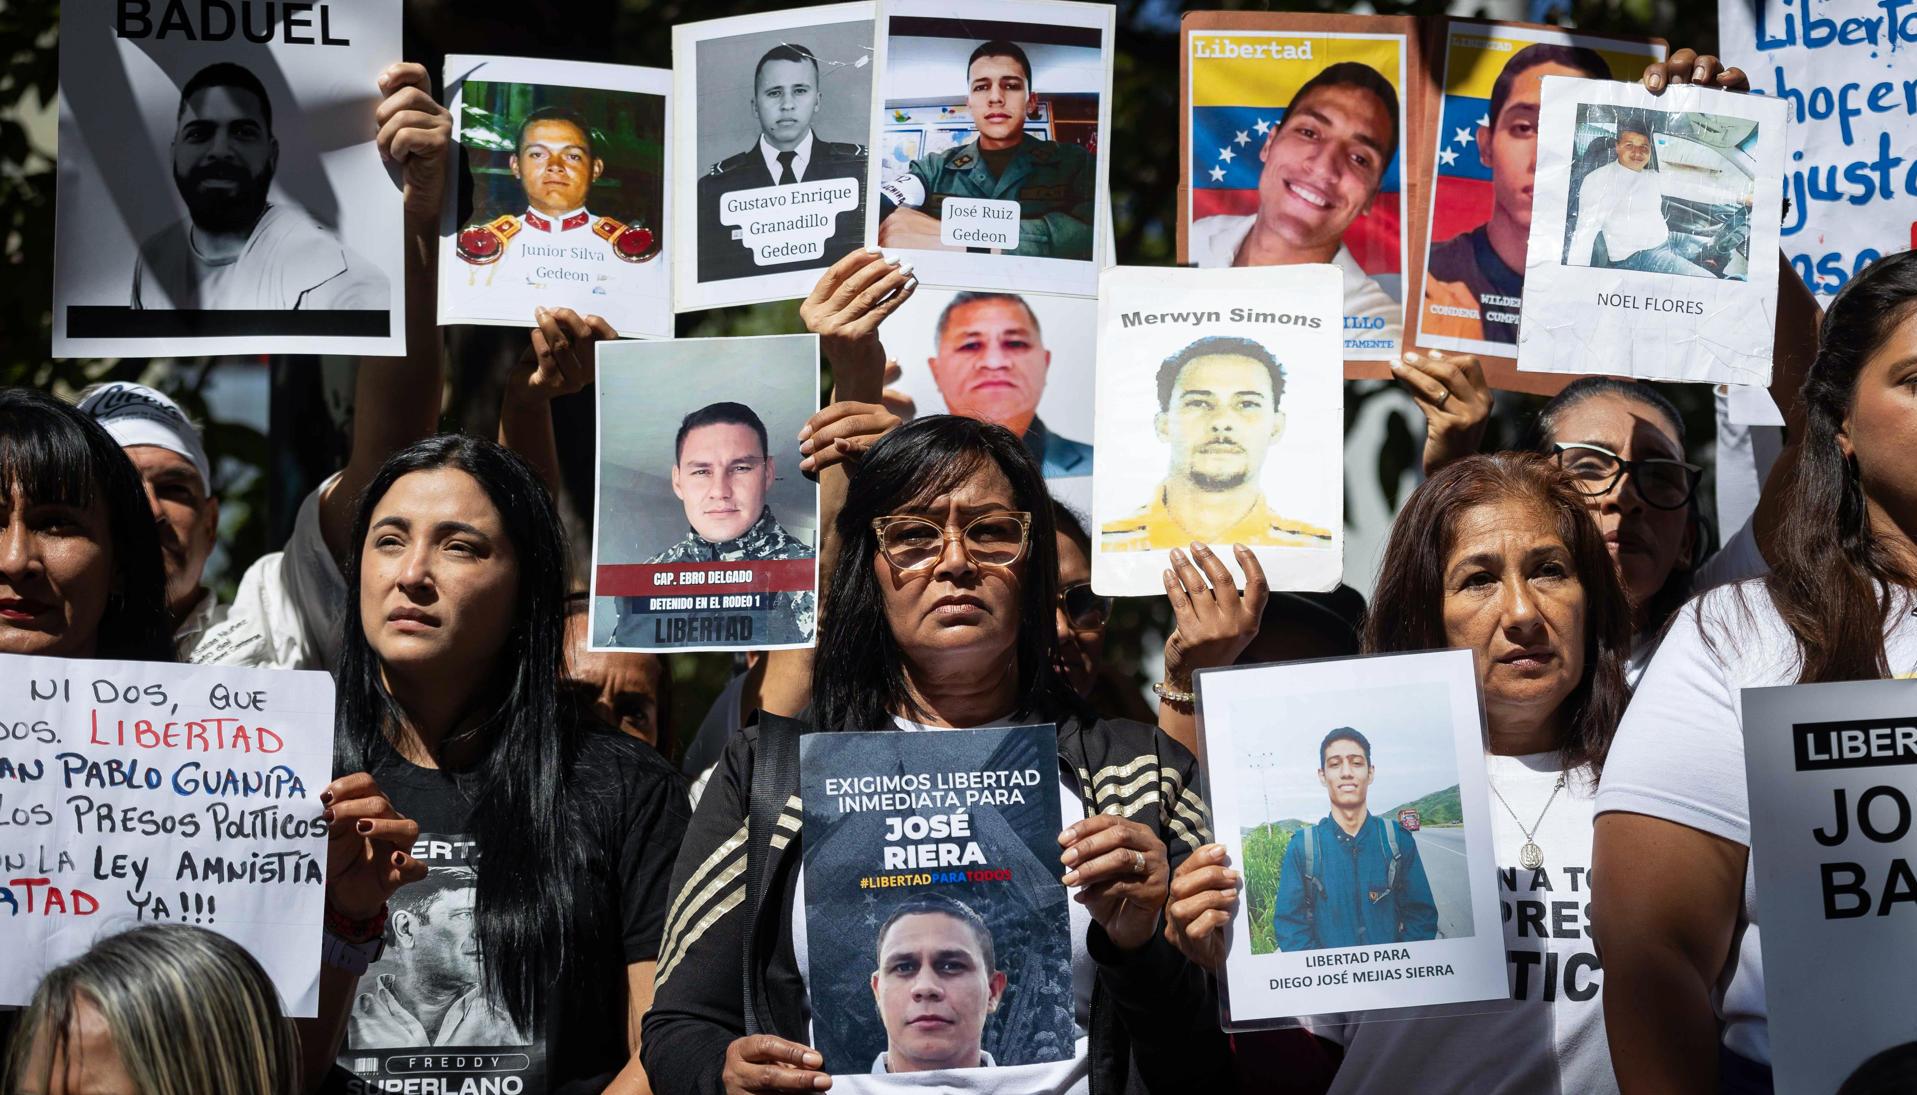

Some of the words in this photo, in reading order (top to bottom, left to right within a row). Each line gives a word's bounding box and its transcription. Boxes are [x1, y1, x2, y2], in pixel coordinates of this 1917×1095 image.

[117, 0, 350, 46] BADUEL
[1195, 39, 1313, 60] Libertad
[1748, 66, 1917, 146] hofer
[728, 195, 786, 213] Gustavo
[791, 187, 851, 205] Enrique
[949, 204, 977, 219] José
[982, 206, 1014, 220] Ruiz
[750, 213, 828, 235] Granadillo
[952, 228, 1007, 244] Gedeon
[522, 243, 567, 258] Junior
[570, 247, 604, 261] Silva
[761, 242, 817, 259] Gedeon
[536, 265, 589, 282] Gedeon
[1597, 293, 1640, 310] NOEL
[1645, 297, 1704, 315] FLORES
[1120, 309, 1221, 329] Merwyn
[1229, 308, 1323, 329] Simons
[653, 571, 677, 586] CAP.
[680, 571, 705, 585] EBRO
[707, 570, 753, 584] DELGADO
[650, 597, 694, 611] DETENIDO
[696, 597, 708, 610] EN
[709, 596, 721, 609] EL
[723, 595, 753, 609] RODEO
[755, 595, 760, 607] 1
[655, 615, 754, 644] LIBERTAD
[31, 678, 70, 703] NI
[209, 683, 268, 711] QUE
[90, 709, 284, 753] LIBERTAD
[1806, 726, 1917, 761] LIBER
[55, 752, 162, 790] PABLO
[172, 761, 307, 799] GUANIPA
[825, 773, 931, 796] EXIGIMOS
[937, 769, 1041, 790] LIBERTAD
[838, 791, 962, 813] INMEDIATA
[966, 788, 1026, 807] PARA
[67, 795, 200, 837] PRESOS
[885, 807, 971, 842] JOSÉ
[1812, 785, 1912, 847] JO
[883, 841, 988, 871] RIERA
[38, 845, 76, 875] LA
[94, 845, 149, 893] LEY
[859, 868, 1013, 889] #LIBERTADPARATODOS
[1529, 866, 1554, 892] A
[1563, 866, 1592, 892] T
[1305, 951, 1370, 968] LIBERTAD
[1373, 948, 1411, 963] PARA
[1269, 975, 1313, 990] DIEGO
[1316, 969, 1349, 986] JOSÉ
[1352, 967, 1402, 984] MEJIAS
[1405, 963, 1455, 979] SIERRA
[409, 1056, 501, 1069] FREDDY
[346, 1075, 524, 1095] SUPERLANO
